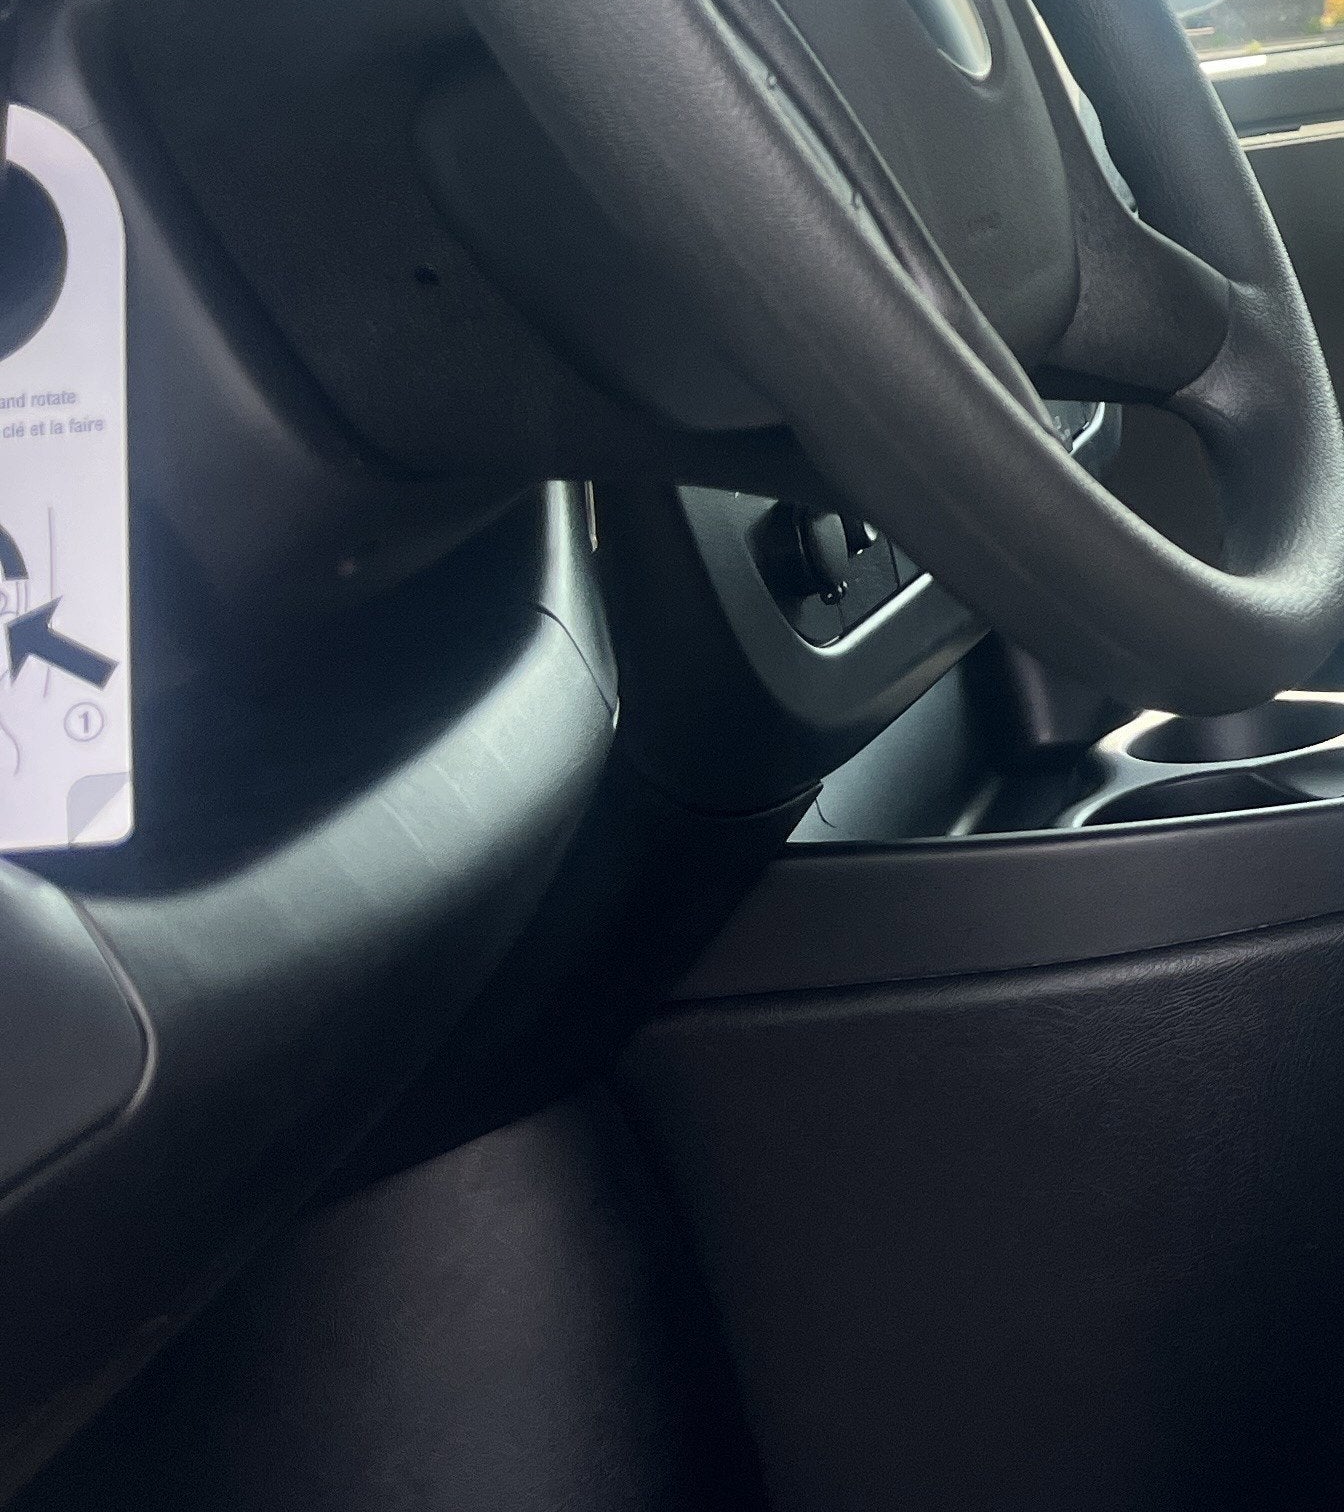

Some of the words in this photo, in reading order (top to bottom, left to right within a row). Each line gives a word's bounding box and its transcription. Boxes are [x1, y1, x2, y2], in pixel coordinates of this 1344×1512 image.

[31, 390, 77, 407] rotate
[3, 422, 25, 439] clé
[31, 421, 46, 437] et
[50, 419, 63, 435] la
[69, 417, 104, 434] faire
